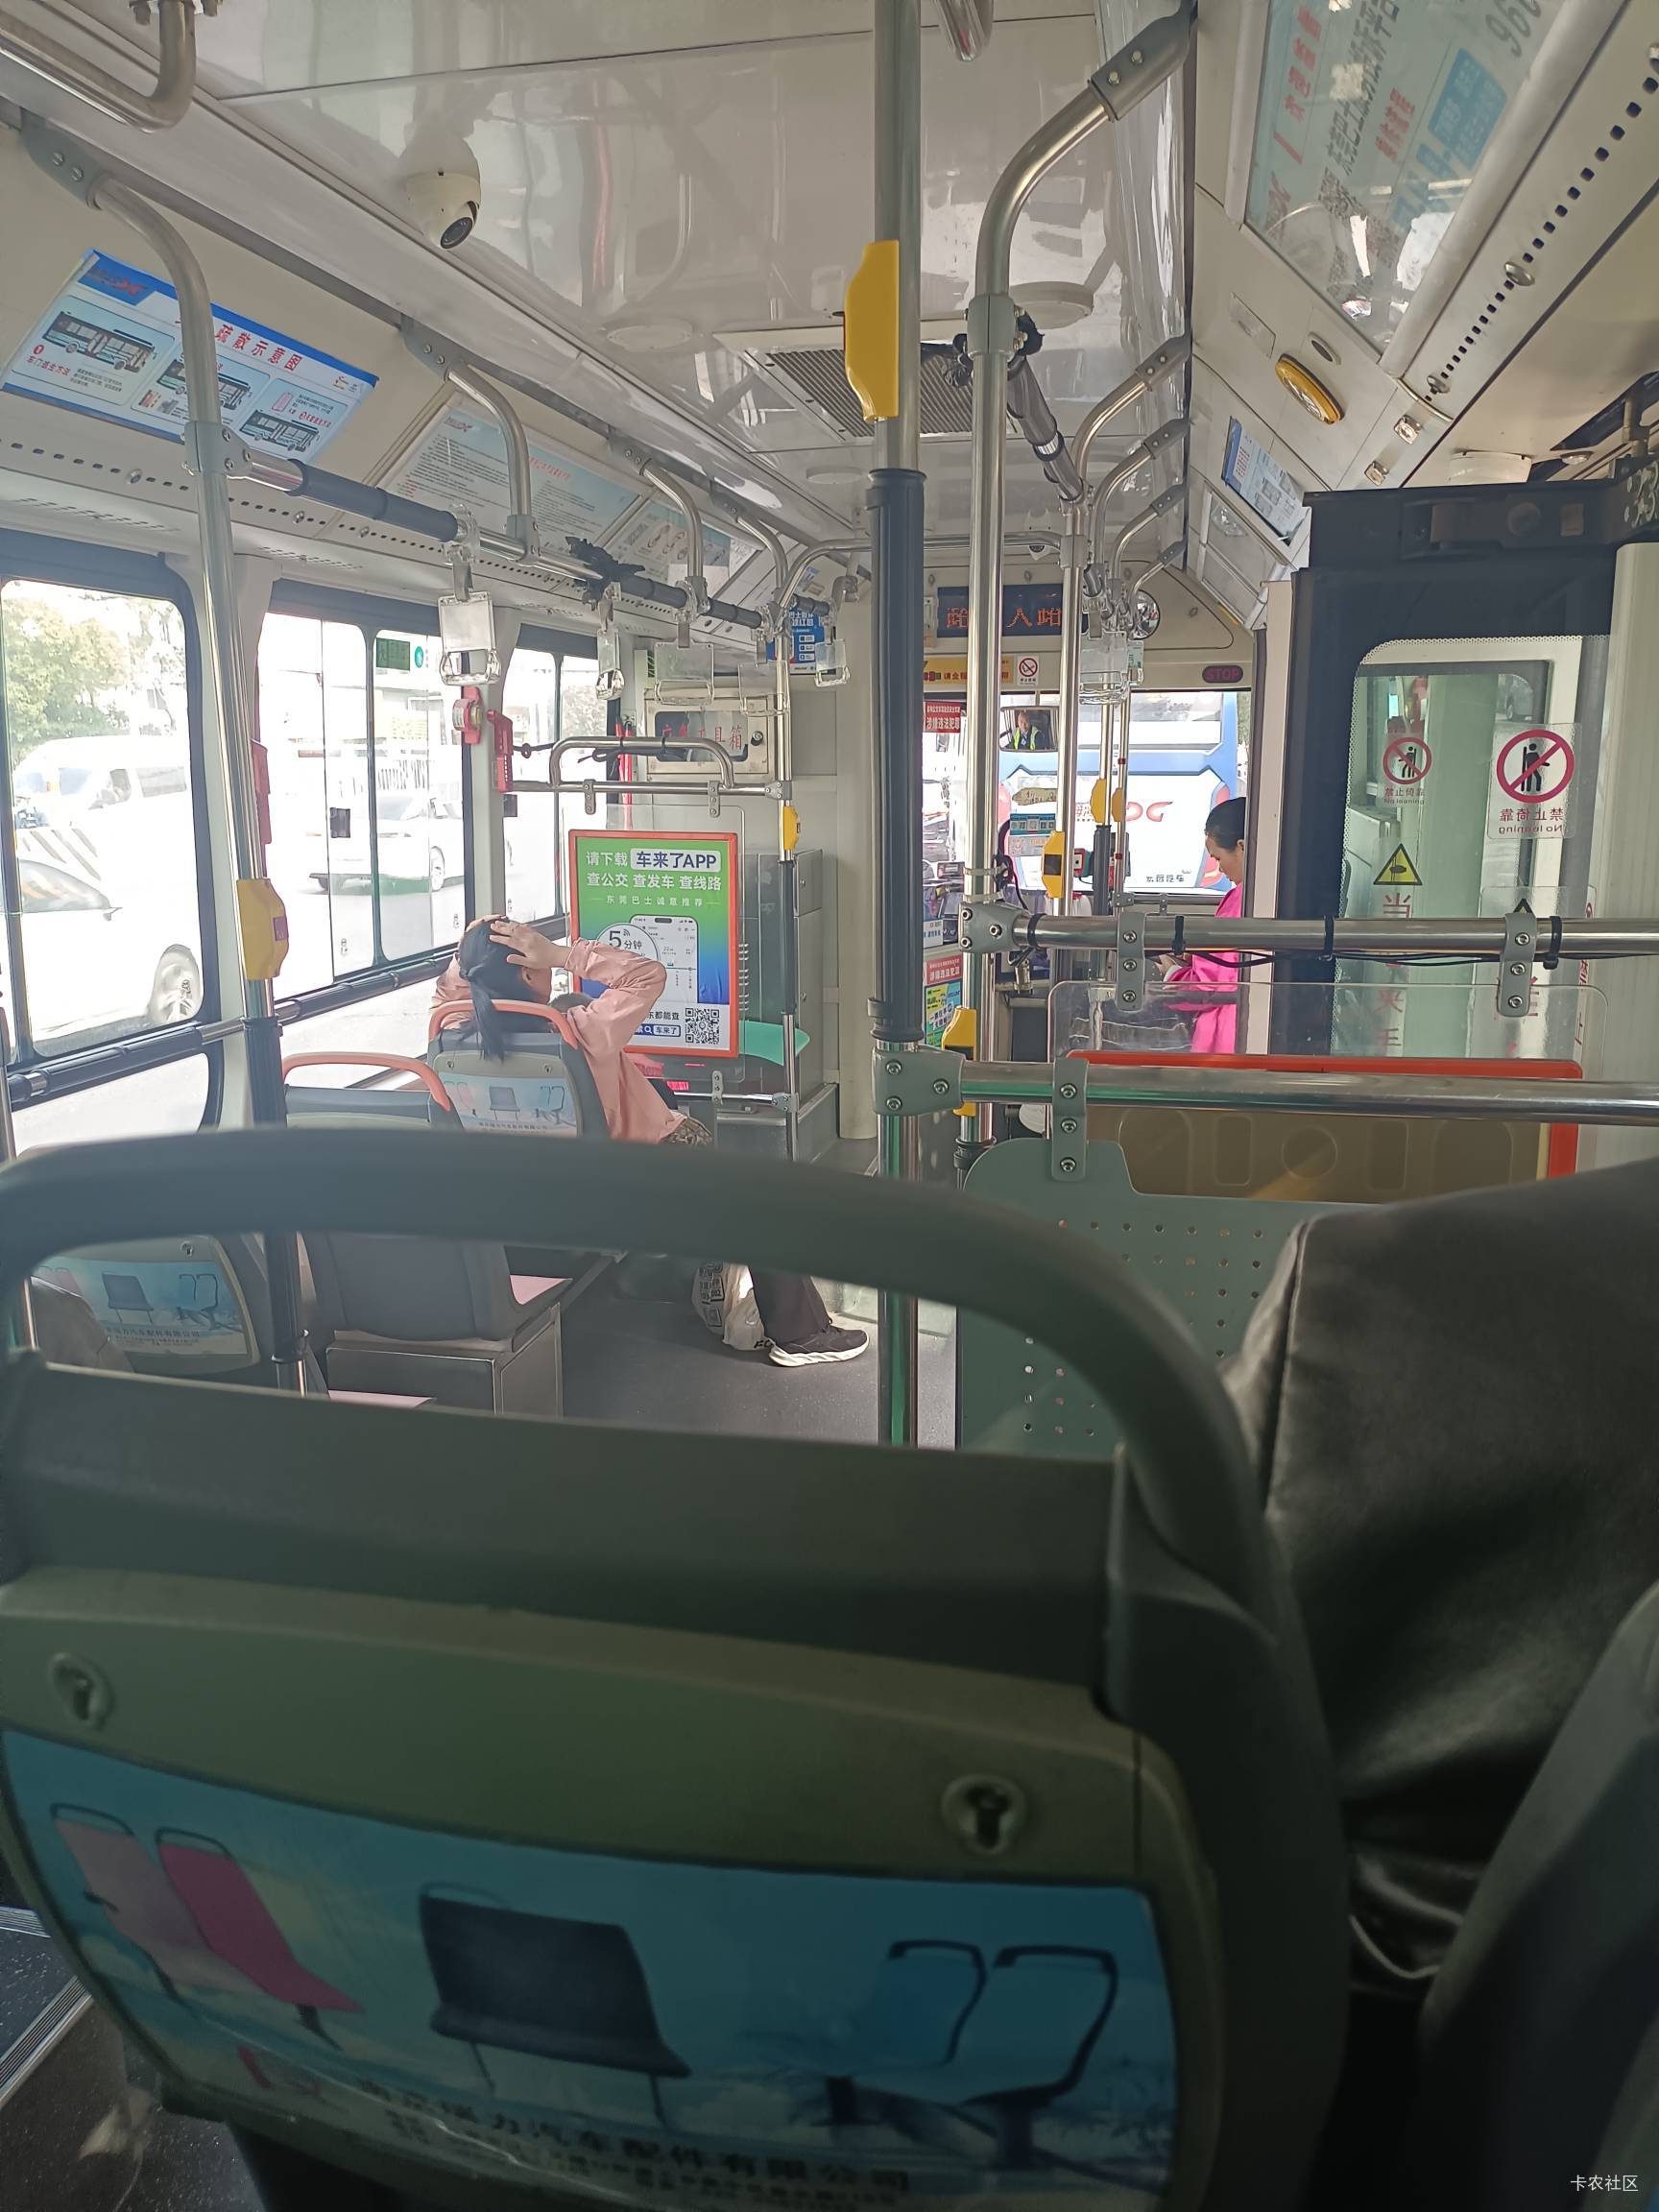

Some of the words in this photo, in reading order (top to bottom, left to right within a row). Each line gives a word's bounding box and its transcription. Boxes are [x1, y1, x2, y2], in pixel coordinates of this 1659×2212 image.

[586, 851, 629, 867] 请下载
[637, 851, 717, 869] 车来了APP
[587, 872, 629, 888] 查公交
[634, 873, 675, 889] 查发车
[679, 875, 722, 892] 查线路
[609, 929, 622, 950] 5
[624, 940, 642, 950] 分钟
[654, 1025, 678, 1035] 车来了
